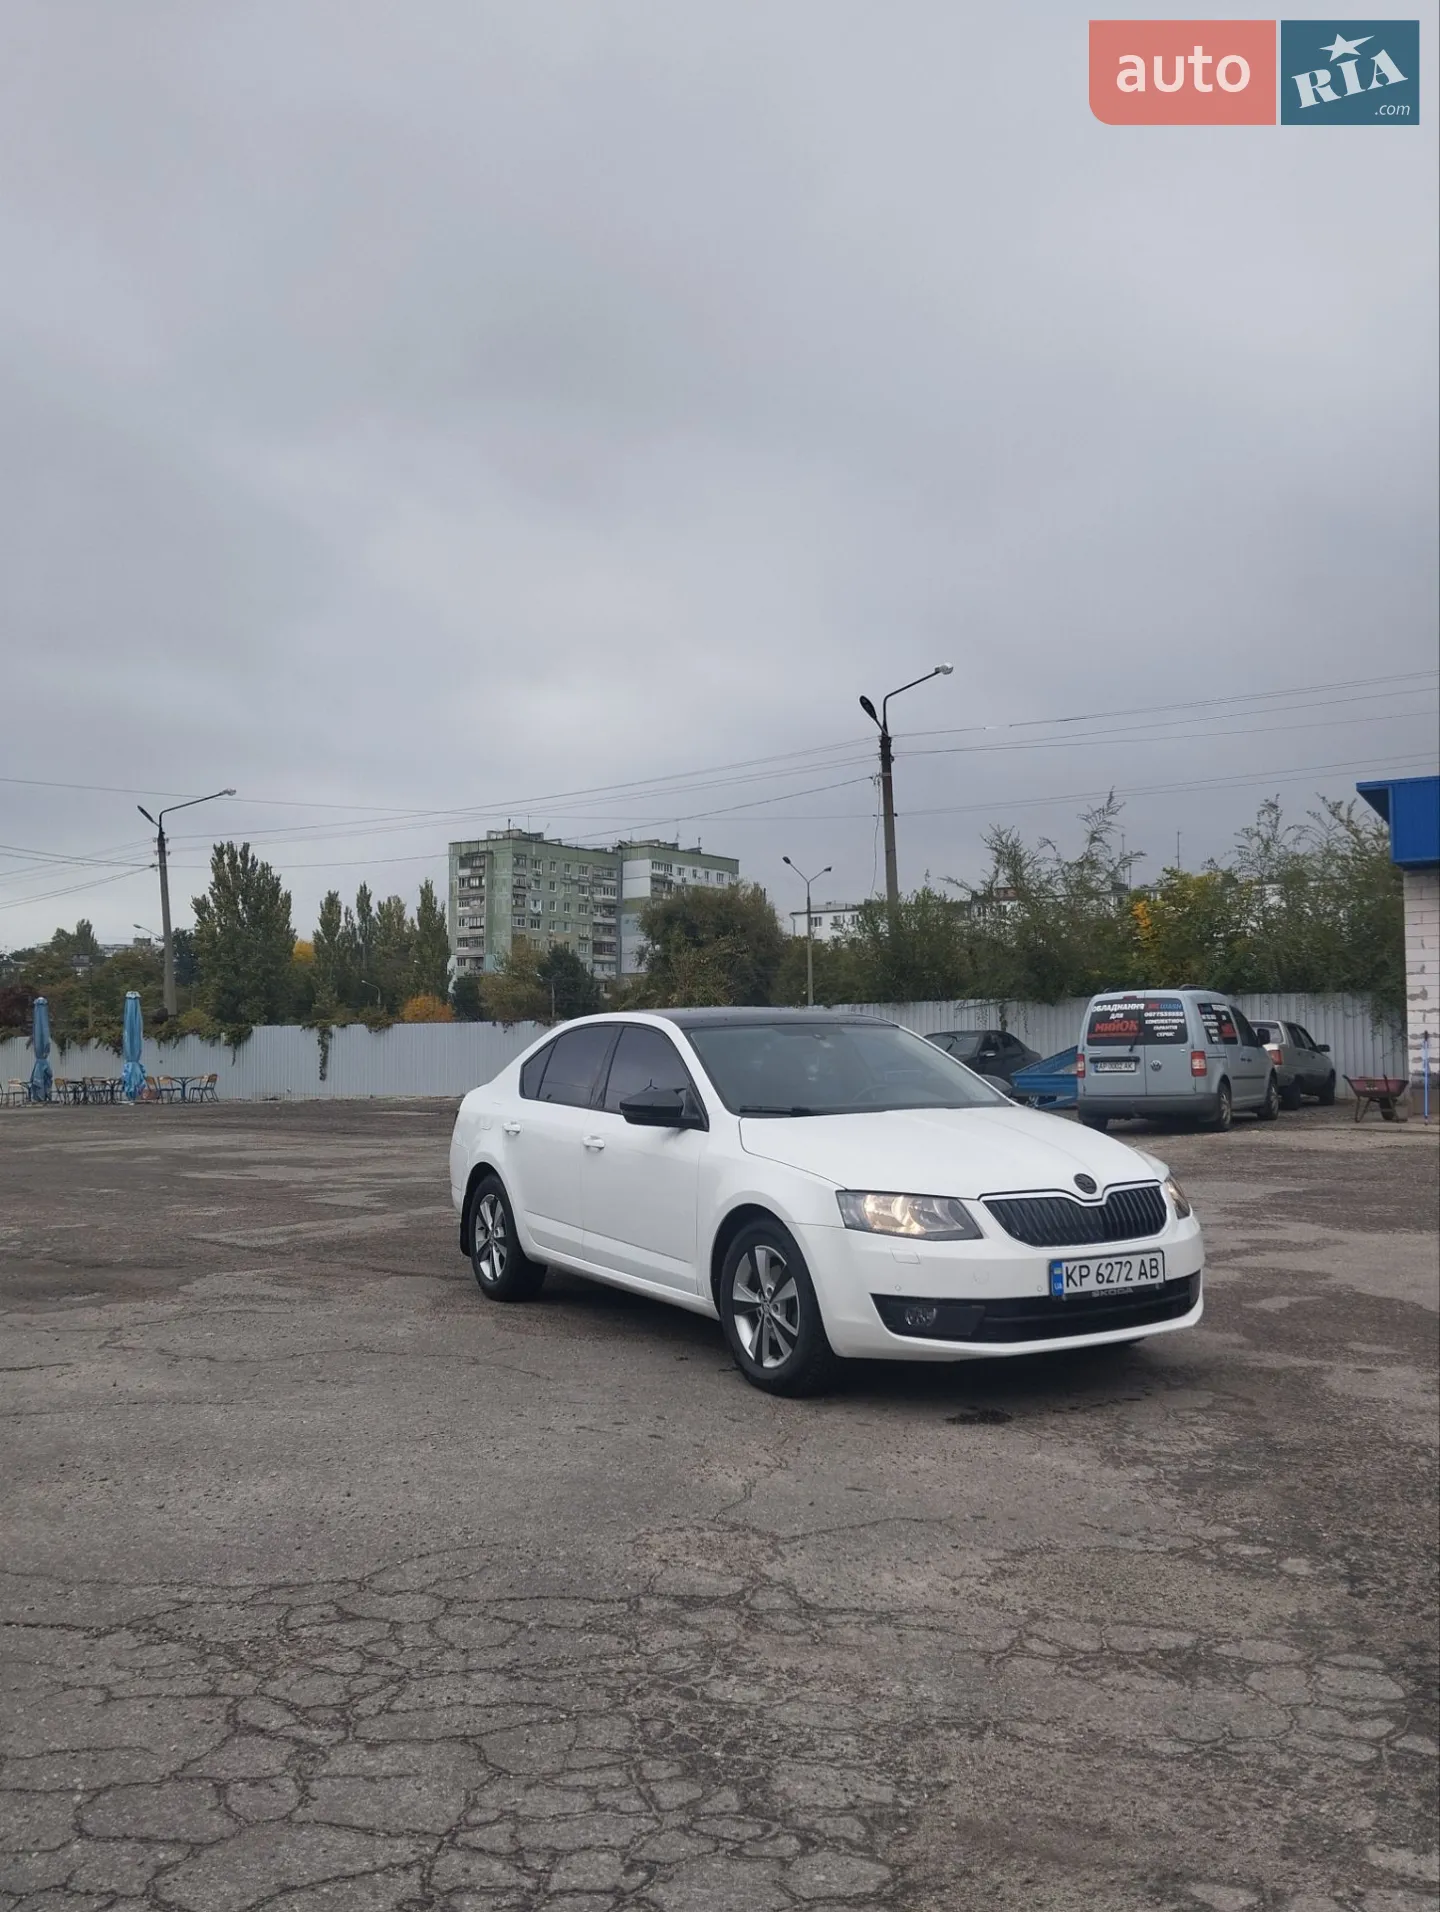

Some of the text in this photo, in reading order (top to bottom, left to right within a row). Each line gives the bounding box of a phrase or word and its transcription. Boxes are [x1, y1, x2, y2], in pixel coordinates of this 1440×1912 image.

[1065, 1257, 1160, 1288] KP 6272 AB
